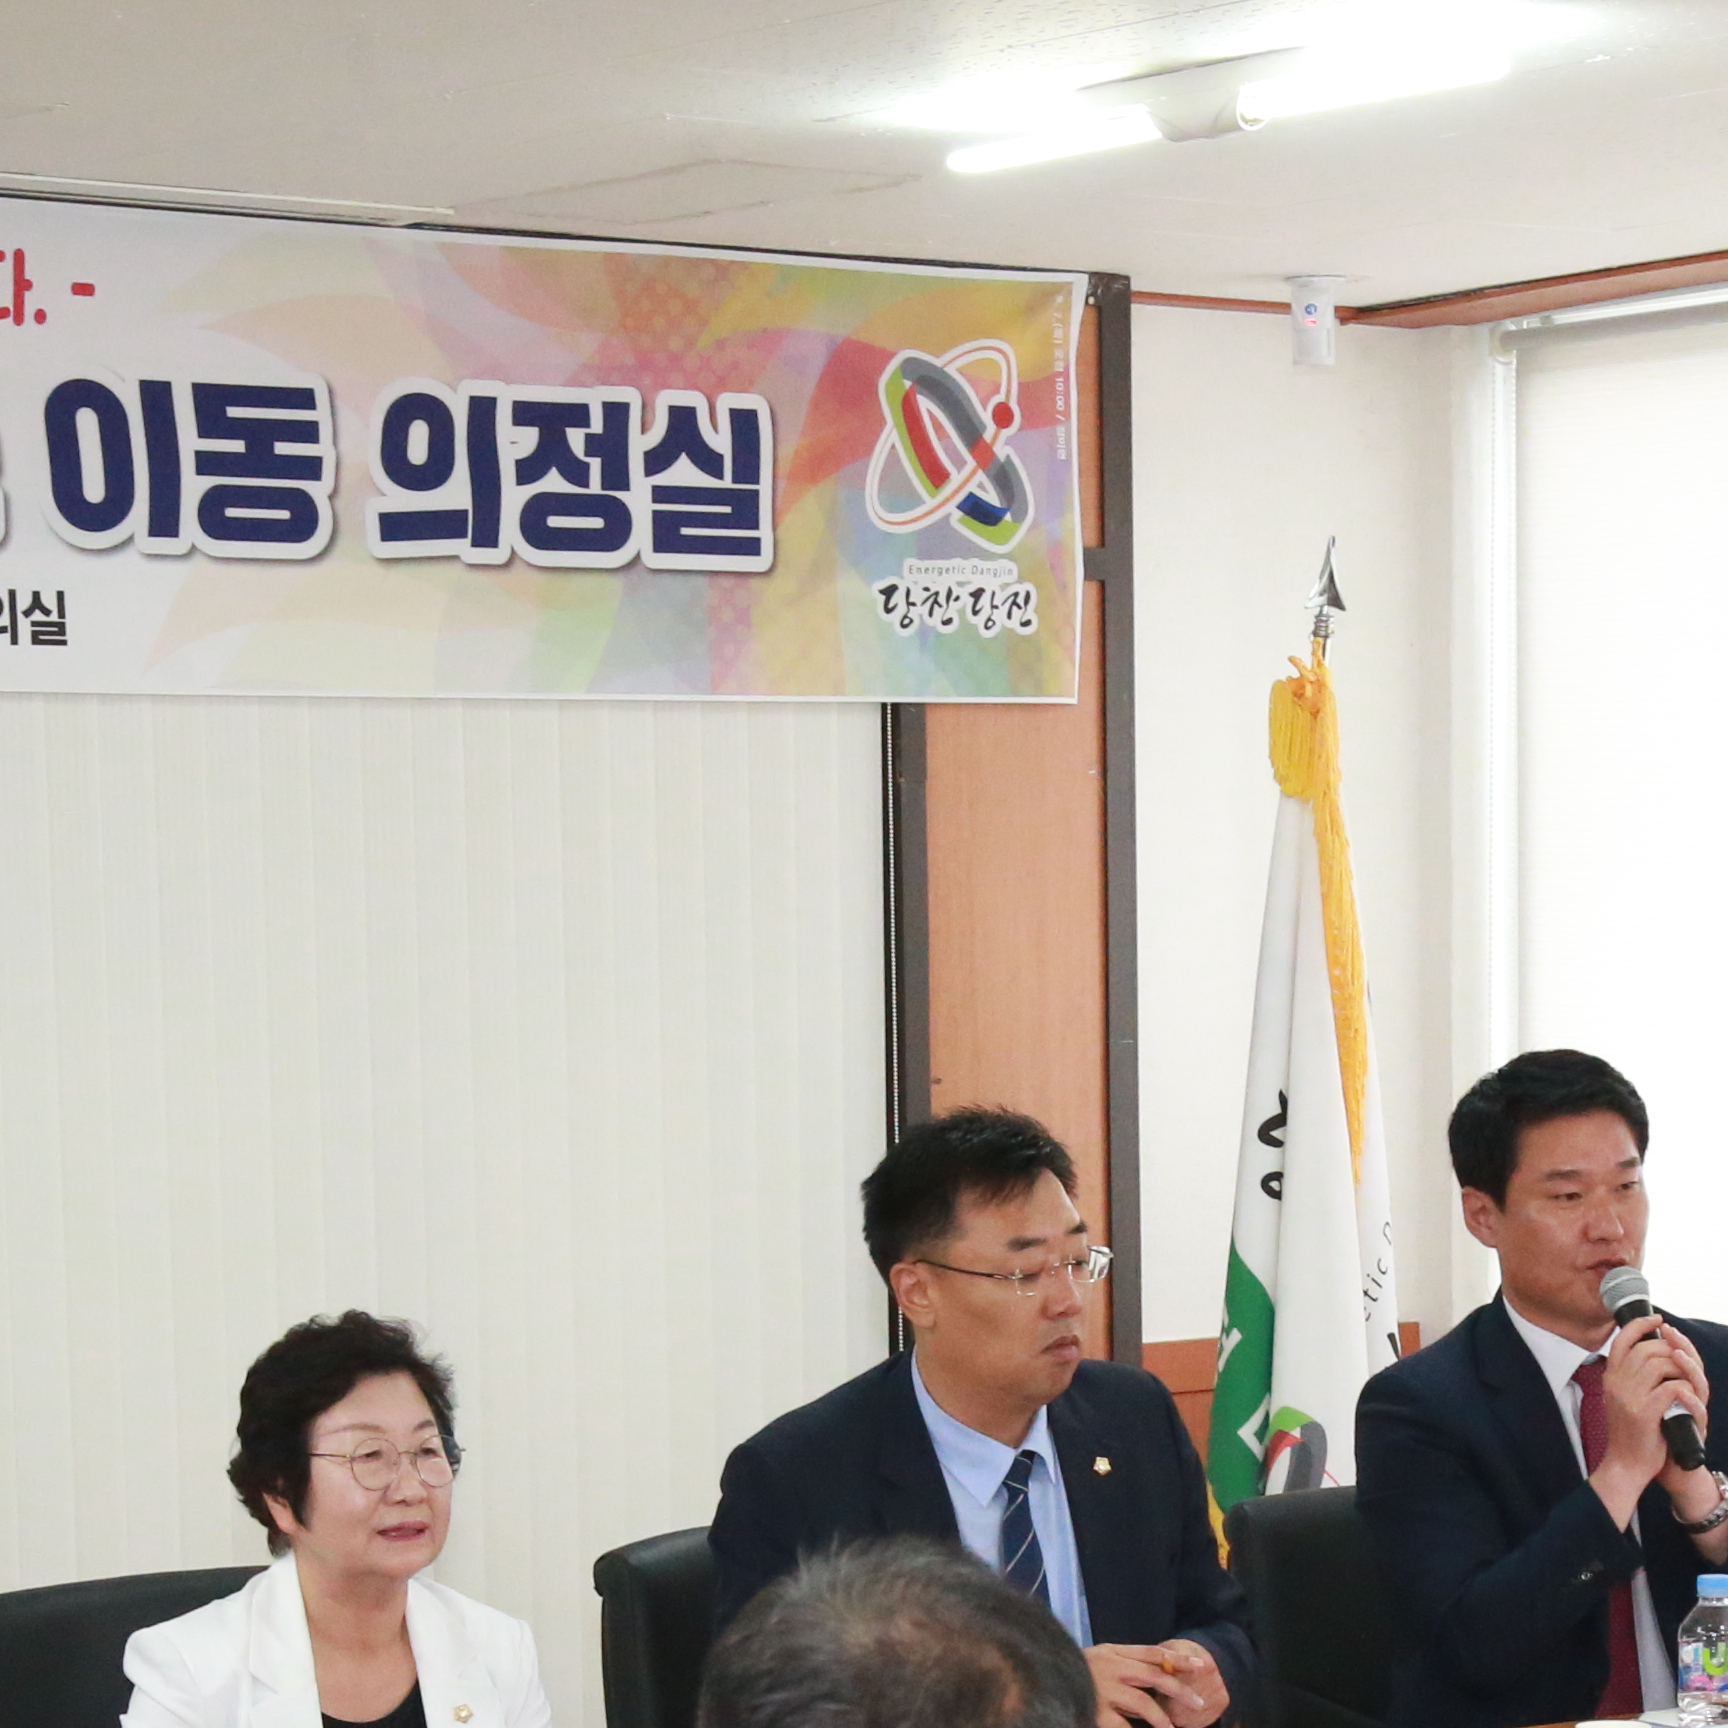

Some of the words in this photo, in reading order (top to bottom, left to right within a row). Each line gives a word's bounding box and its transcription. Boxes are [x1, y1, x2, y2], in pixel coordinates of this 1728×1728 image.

[45, 379, 322, 545] 이동
[379, 393, 762, 556] 의정실
[908, 564, 967, 576] Energetic
[971, 564, 1014, 578] Dangjin
[877, 583, 961, 629] 당찬
[969, 586, 1033, 631] 당진
